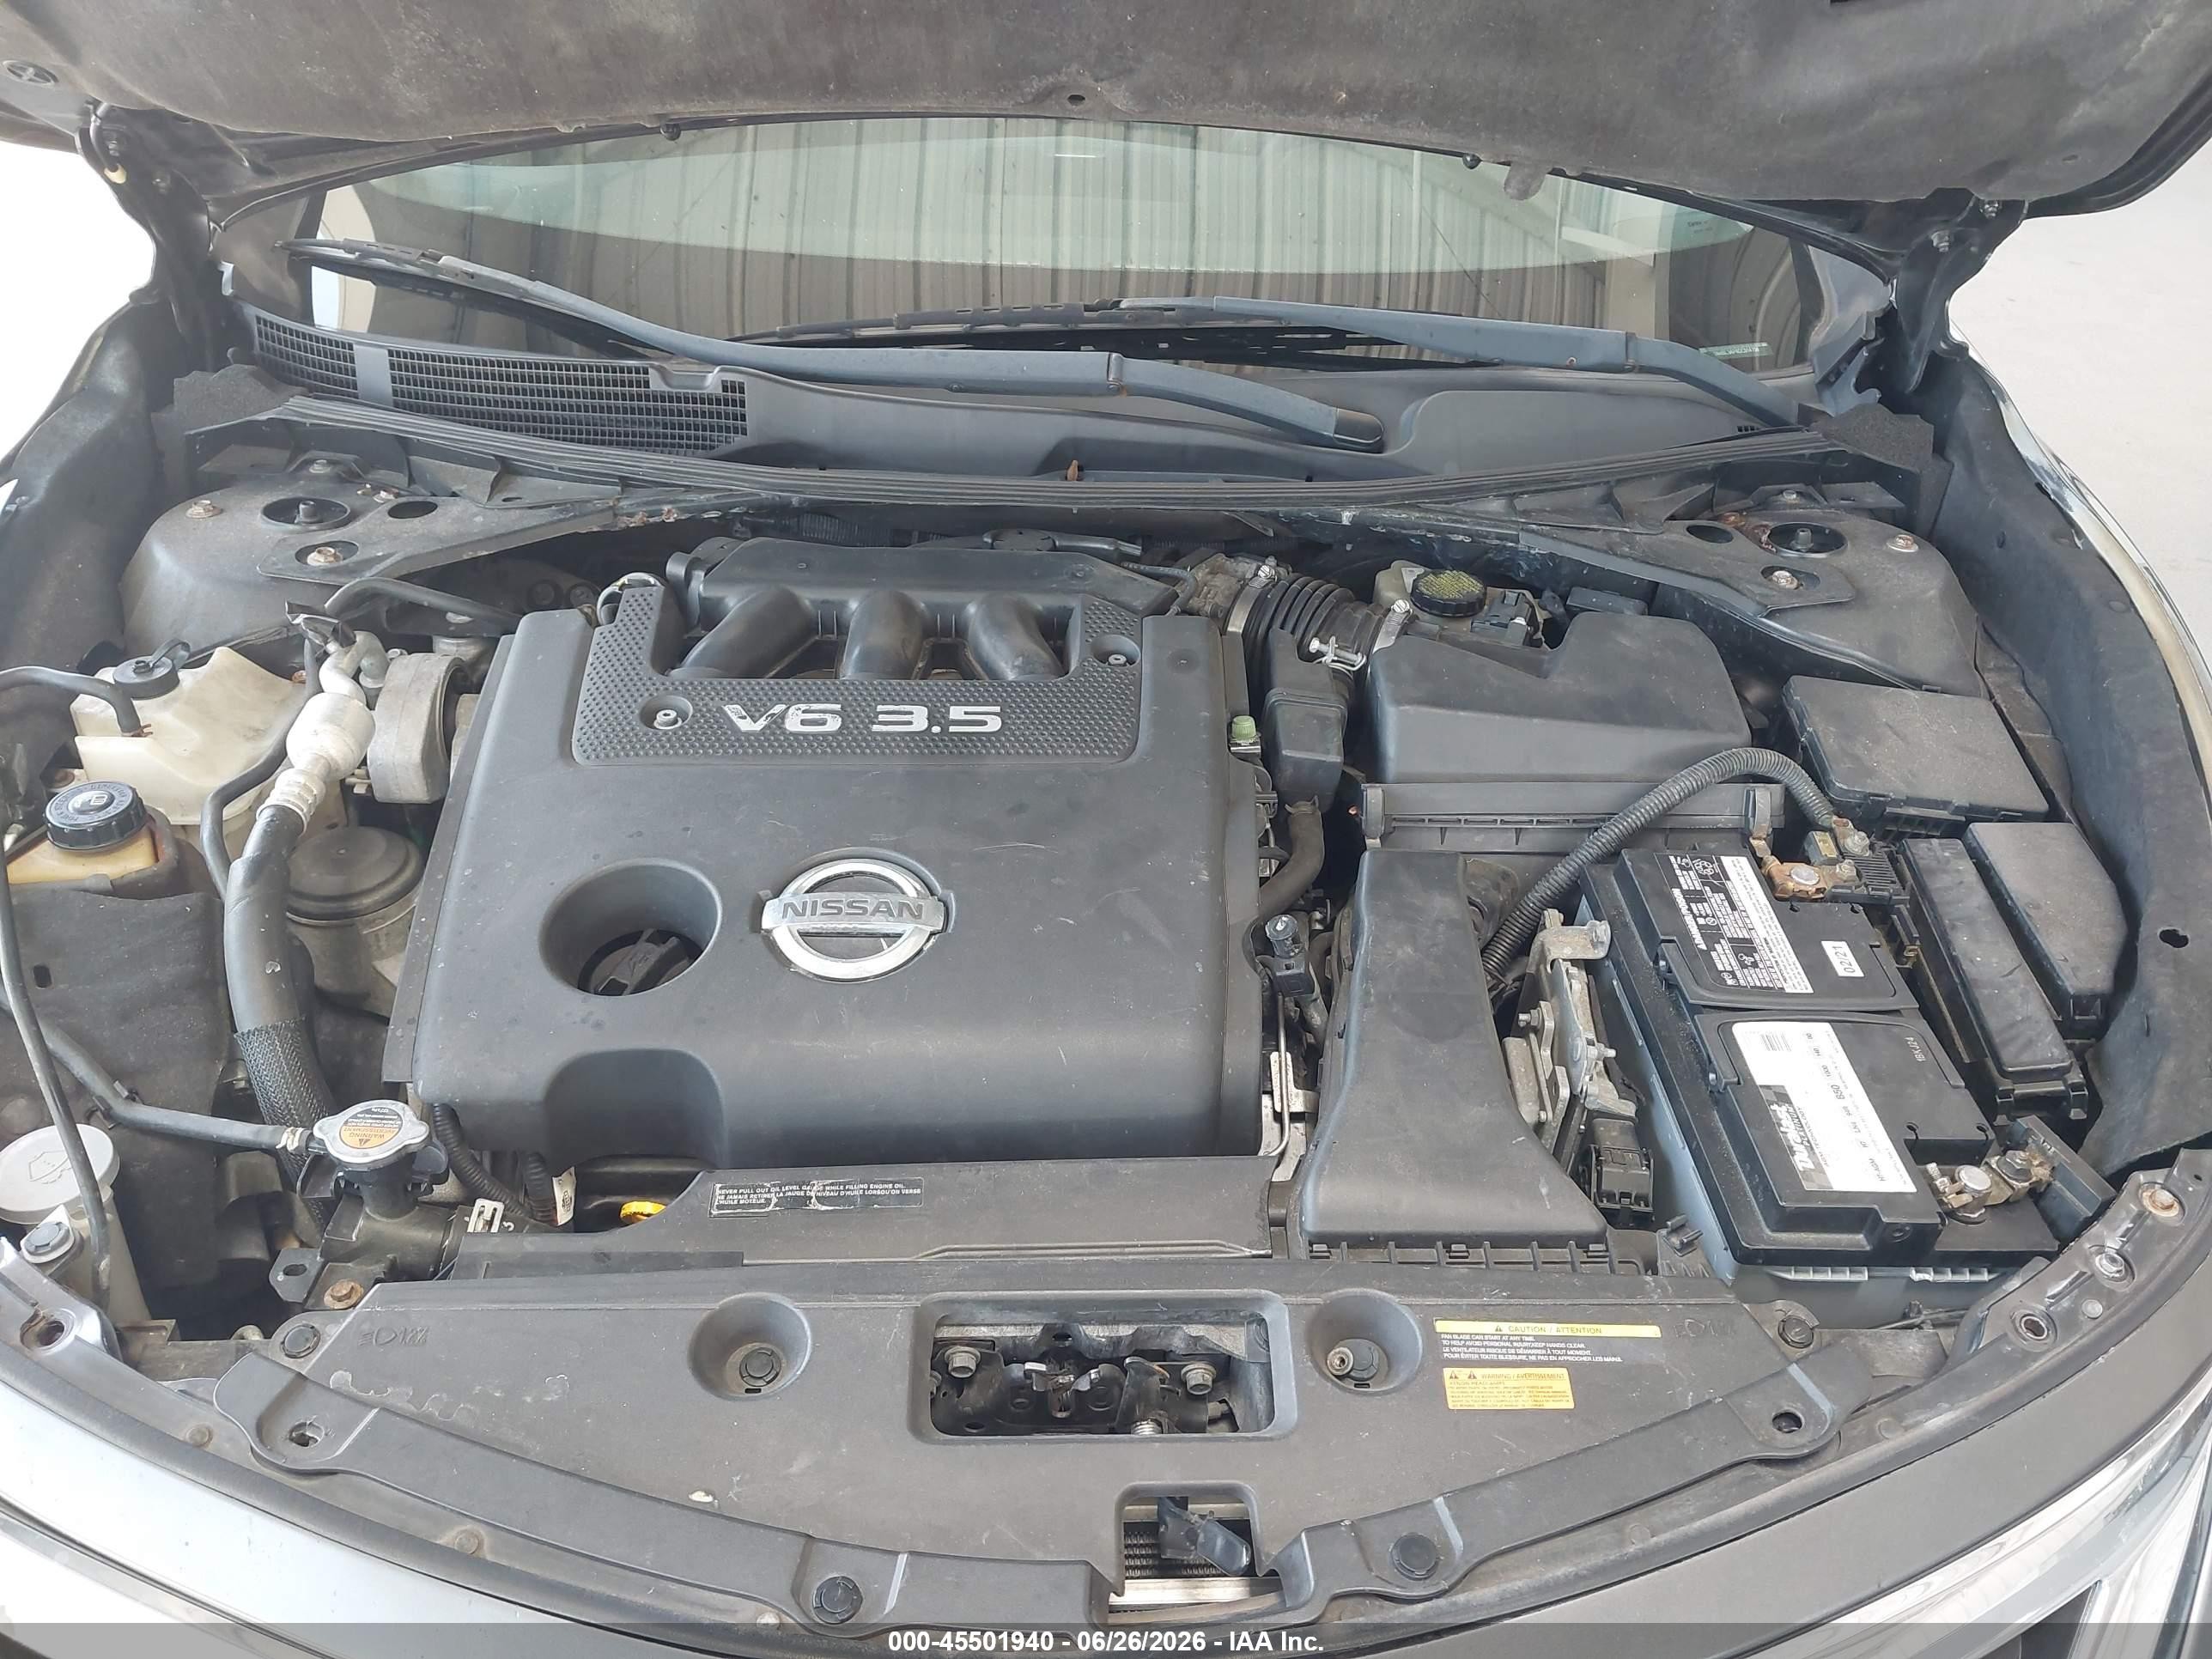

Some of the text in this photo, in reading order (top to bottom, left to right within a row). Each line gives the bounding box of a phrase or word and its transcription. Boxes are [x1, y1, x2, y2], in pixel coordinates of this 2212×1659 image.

[721, 704, 1002, 733] V6 3.5
[782, 899, 923, 920] NISSAN
[1832, 945, 1856, 973] 02/21
[1768, 1103, 1816, 1170] Duralast
[1786, 1106, 1810, 1146] PLATINUM
[1796, 1106, 1820, 1148] TECHNOLOGY
